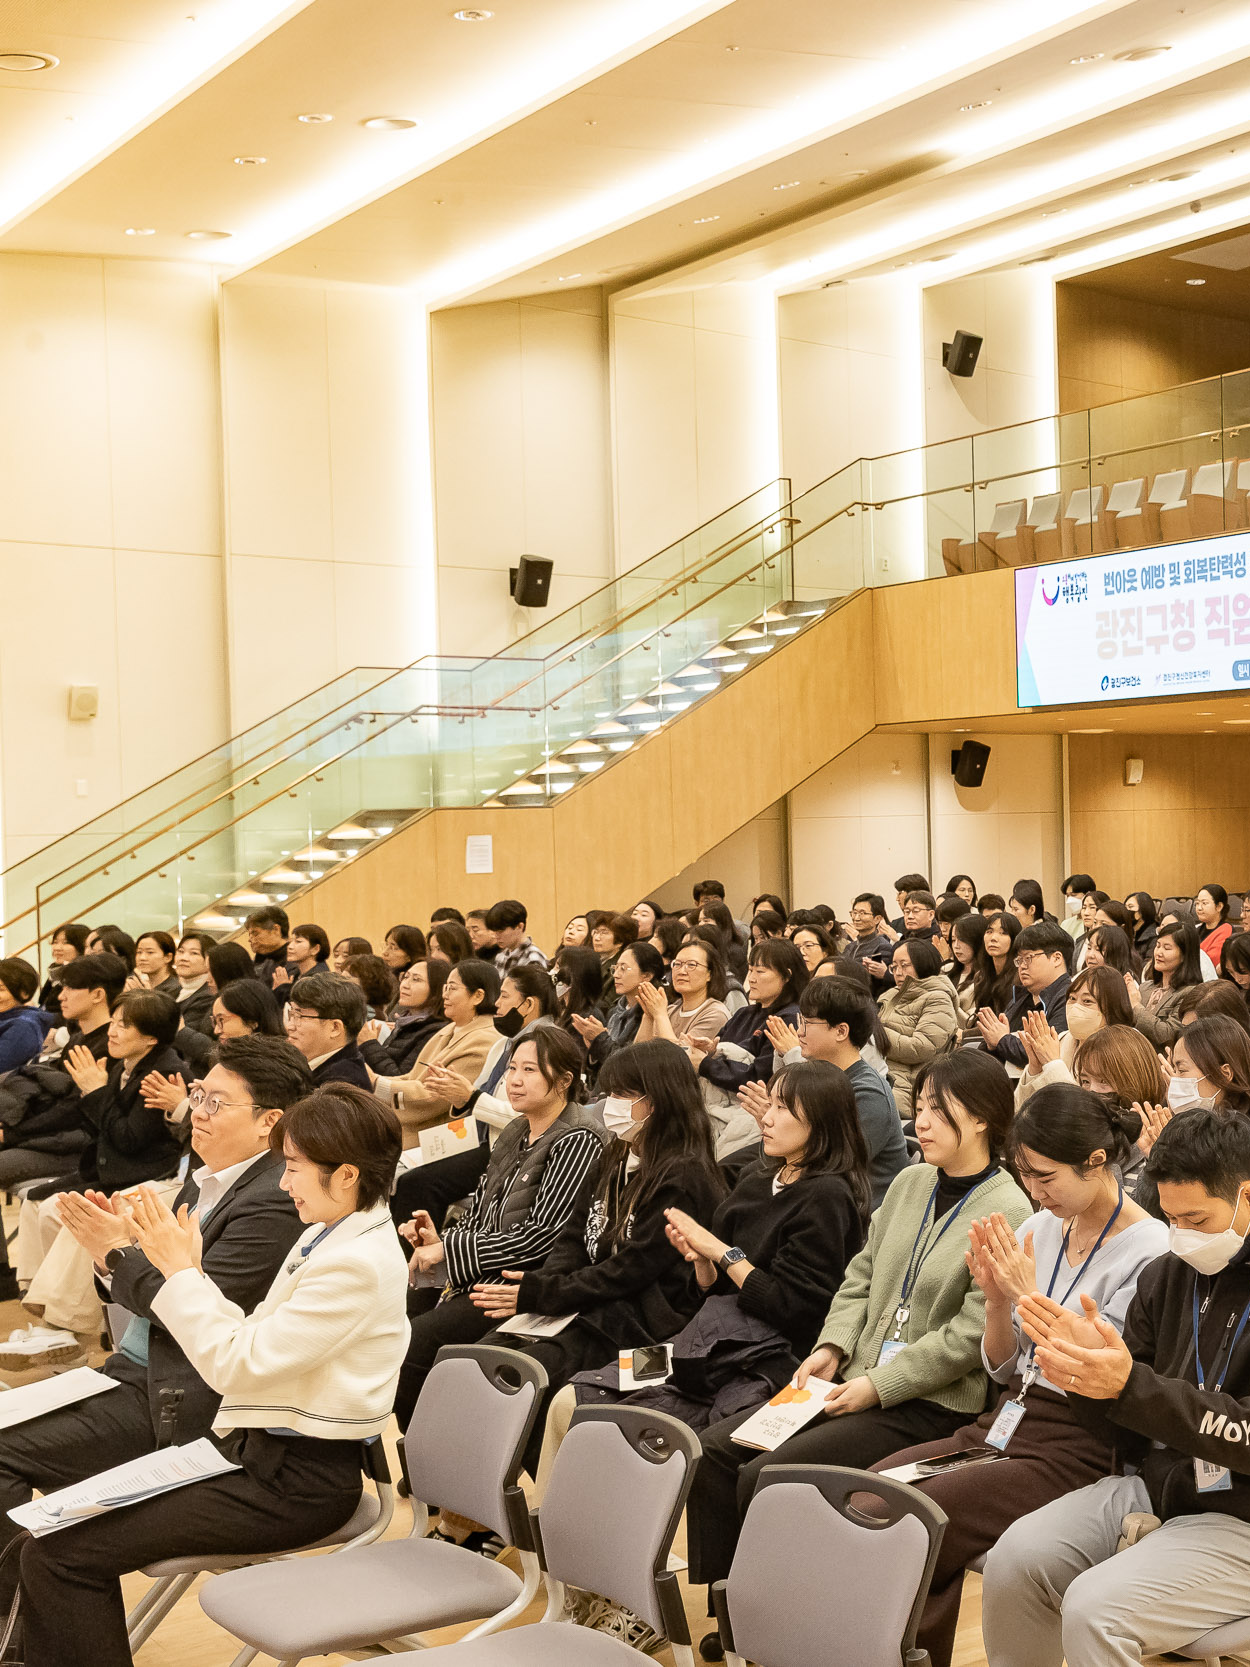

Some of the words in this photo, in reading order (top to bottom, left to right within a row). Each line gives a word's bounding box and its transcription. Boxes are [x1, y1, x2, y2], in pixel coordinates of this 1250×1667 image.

[1103, 568, 1138, 596] 번아웃
[1140, 563, 1166, 590] 예방
[1168, 561, 1181, 587] 및
[1183, 551, 1247, 584] 회복탄력성
[1095, 599, 1196, 661] 광진구청
